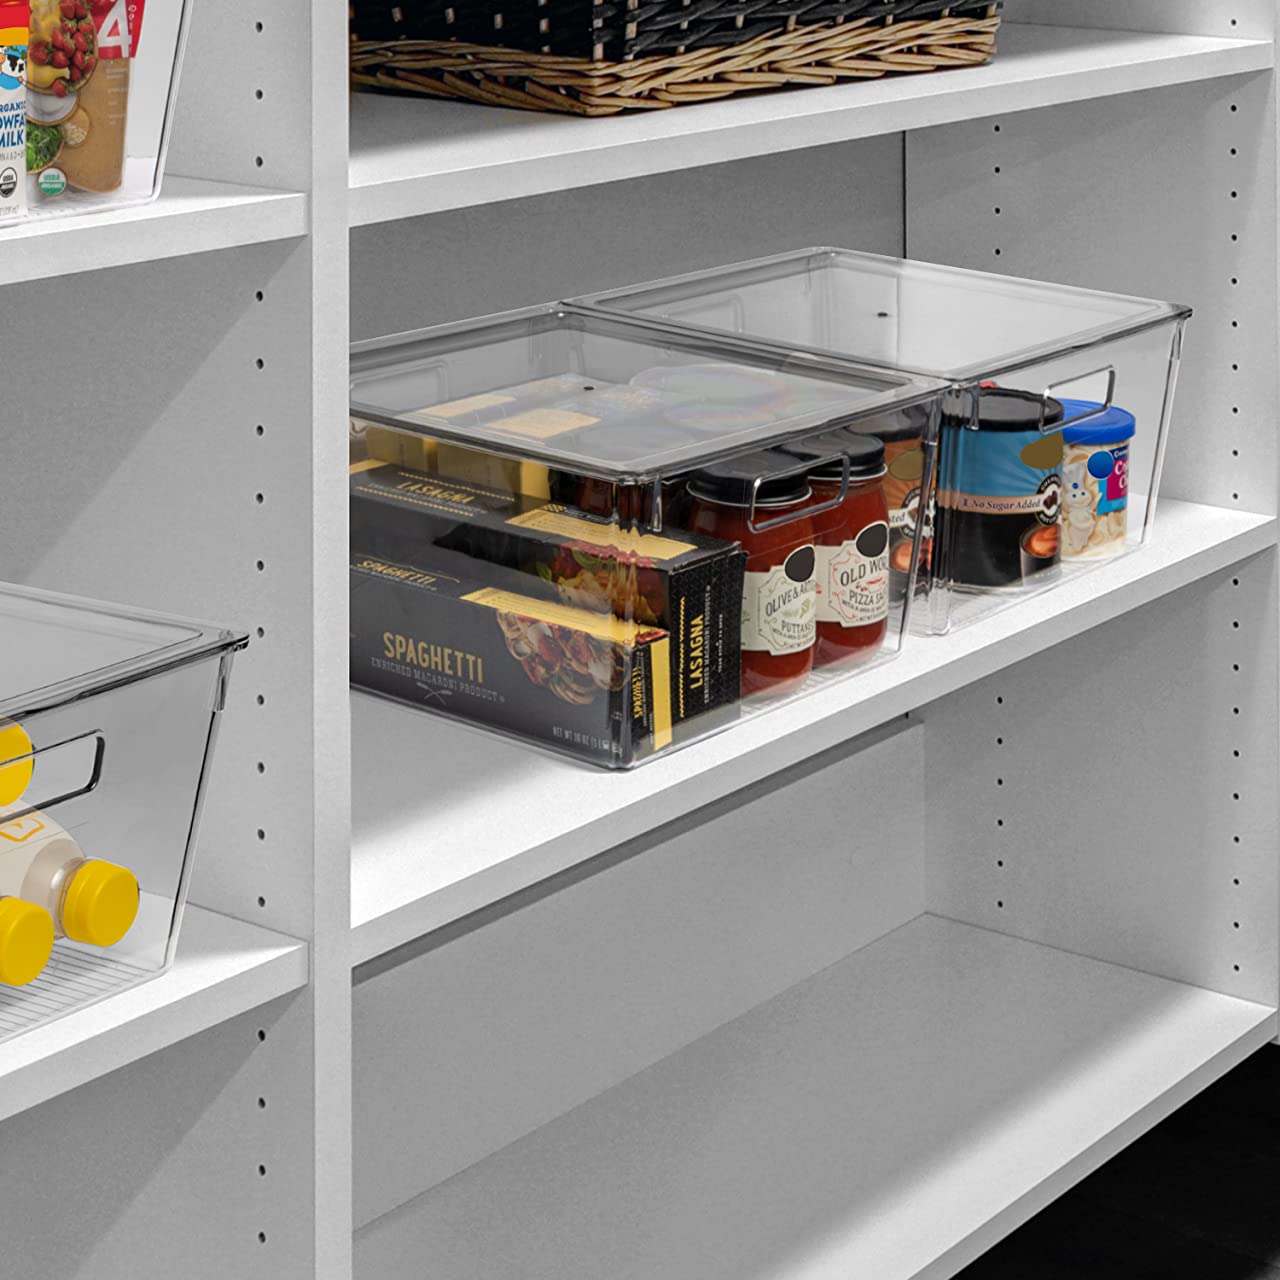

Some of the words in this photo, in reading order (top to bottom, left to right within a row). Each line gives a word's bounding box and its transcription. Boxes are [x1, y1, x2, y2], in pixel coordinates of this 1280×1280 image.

[3, 174, 14, 182] USDA
[973, 499, 985, 508] No
[987, 500, 1015, 511] Sugar
[1016, 499, 1041, 509] Added
[840, 563, 866, 587] OLD
[766, 589, 792, 617] OLIVE
[849, 589, 874, 606] PIZZA
[383, 631, 484, 684] SPAGHETTI
[690, 614, 704, 689] LASAGNA
[371, 656, 412, 678] ENRICHED
[413, 668, 457, 691] MACARONI
[459, 682, 499, 703] PRODUCT
